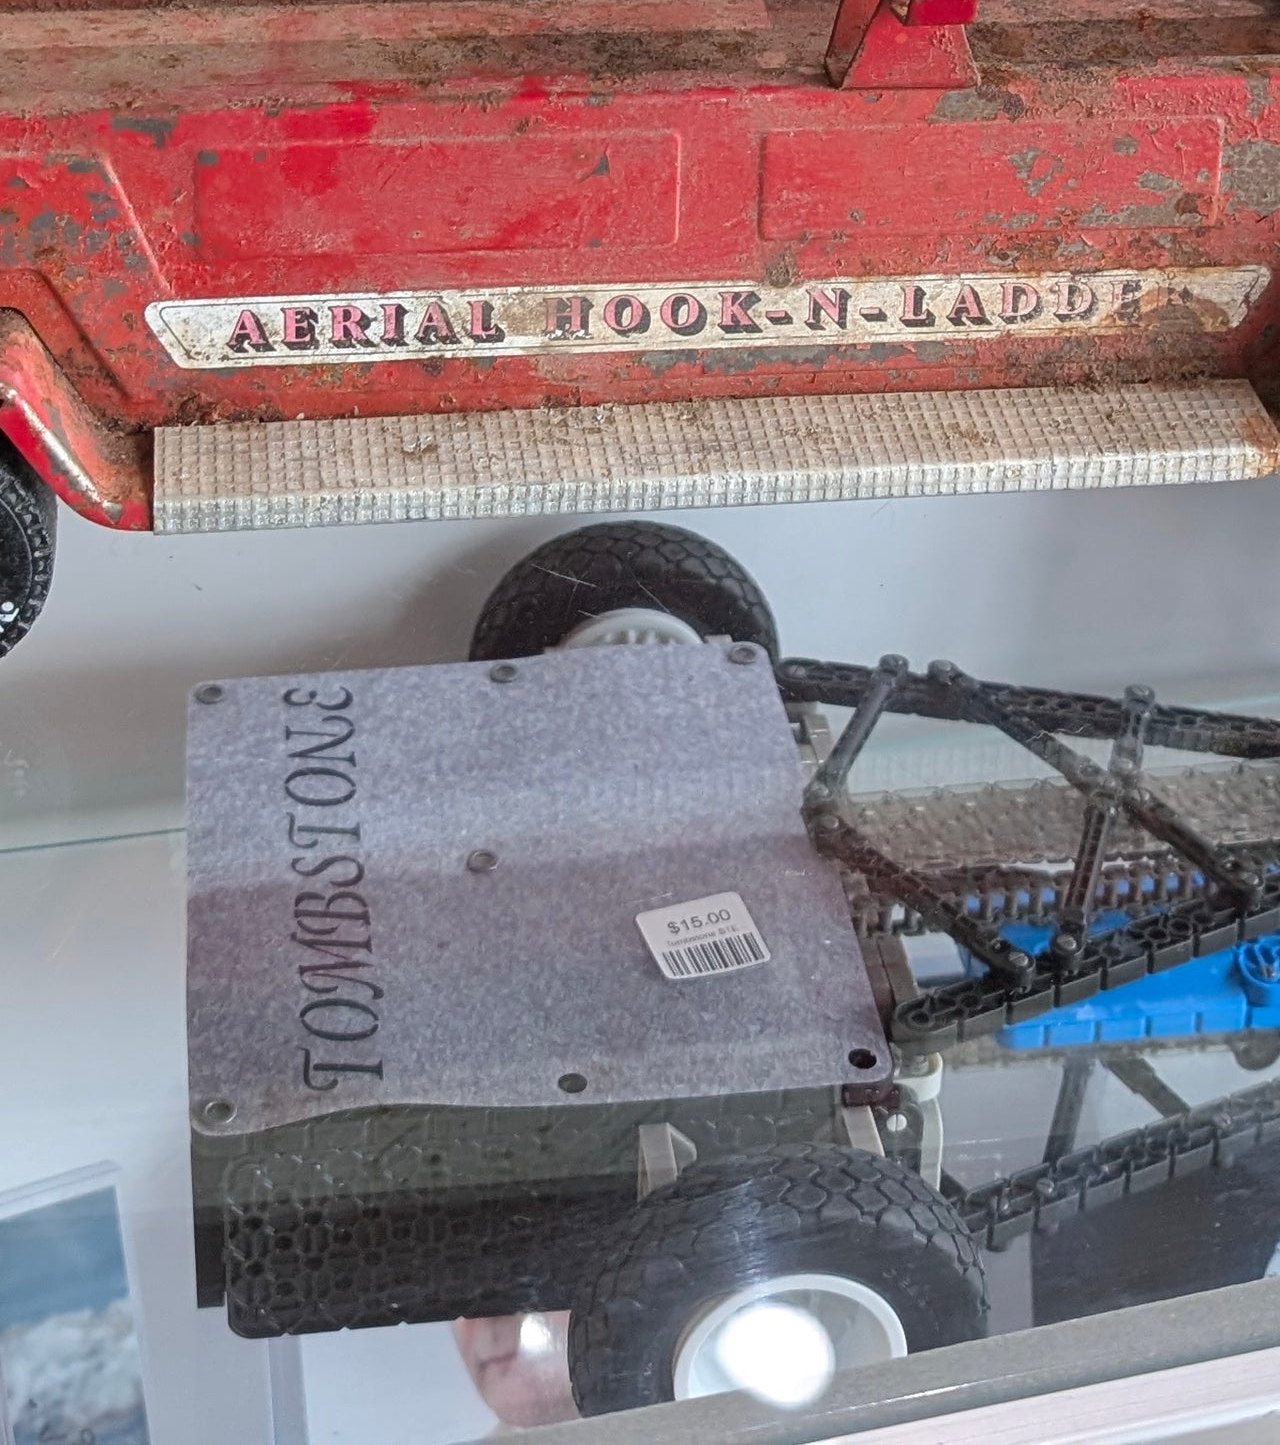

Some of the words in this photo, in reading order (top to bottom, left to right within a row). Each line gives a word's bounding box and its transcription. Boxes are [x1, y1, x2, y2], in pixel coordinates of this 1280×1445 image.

[226, 298, 505, 353] AERIAL
[542, 278, 1194, 342] HOOK-N-LADDE
[283, 685, 384, 1093] TOMBSTONE
[667, 908, 732, 935] $15.00
